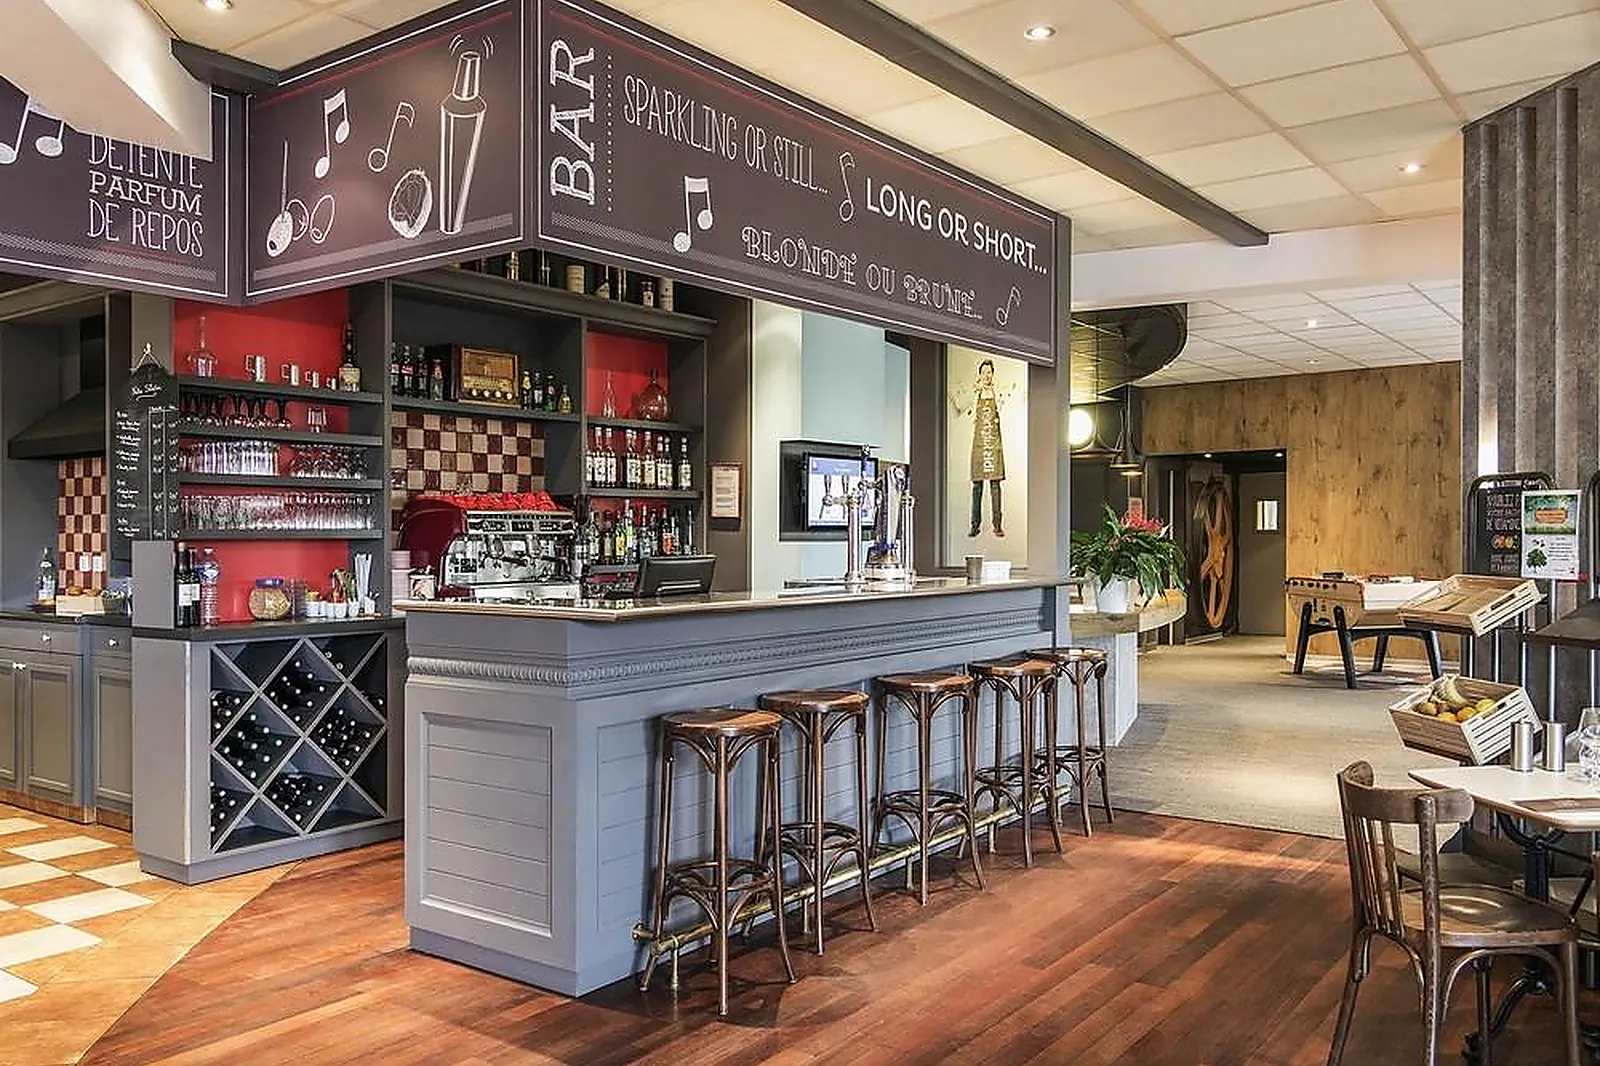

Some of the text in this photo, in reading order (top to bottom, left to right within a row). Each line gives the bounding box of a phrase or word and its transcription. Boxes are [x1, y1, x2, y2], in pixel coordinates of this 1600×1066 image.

[550, 40, 594, 205] BAR
[623, 75, 737, 160] SPARKLING
[745, 124, 768, 173] OR
[87, 198, 203, 257] DE REPOS
[89, 169, 202, 216] PARFUM
[867, 177, 1047, 274] LONG OR SHORT...
[742, 226, 857, 286] BLONDE
[865, 263, 895, 295] OU
